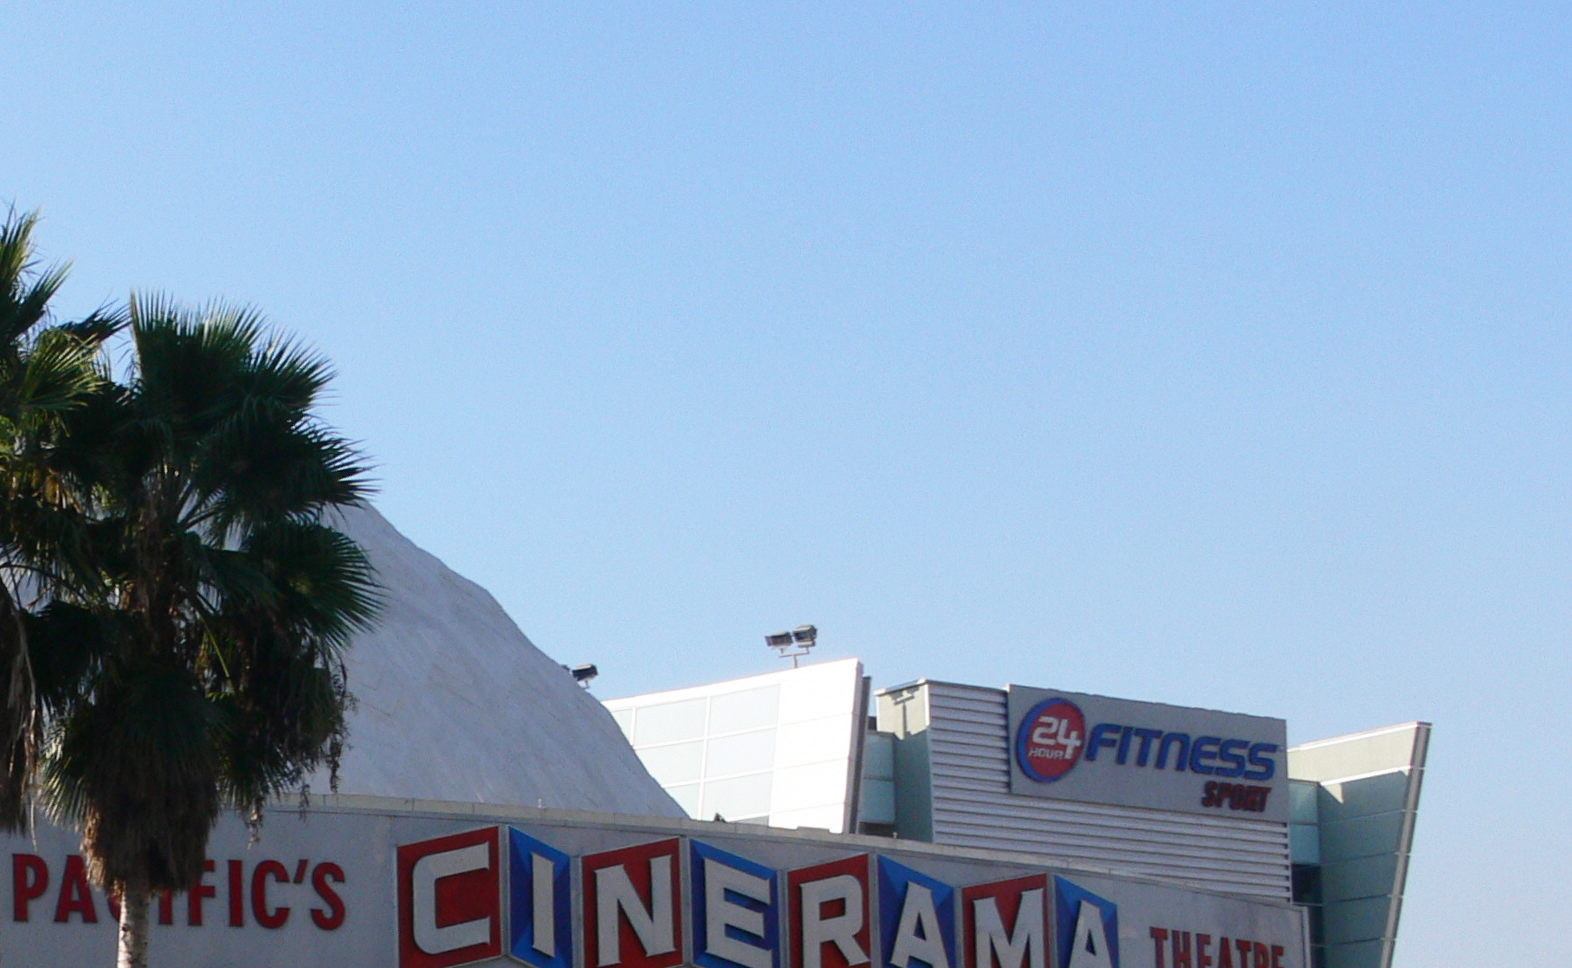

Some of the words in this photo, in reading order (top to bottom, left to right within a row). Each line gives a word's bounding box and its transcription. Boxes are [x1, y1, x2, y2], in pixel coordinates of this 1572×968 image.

[1028, 746, 1064, 760] HOUR
[1032, 715, 1081, 759] 24
[1085, 724, 1279, 780] FITNESS
[1201, 780, 1272, 813] SPORT
[12, 853, 345, 931] PAIFIC'S
